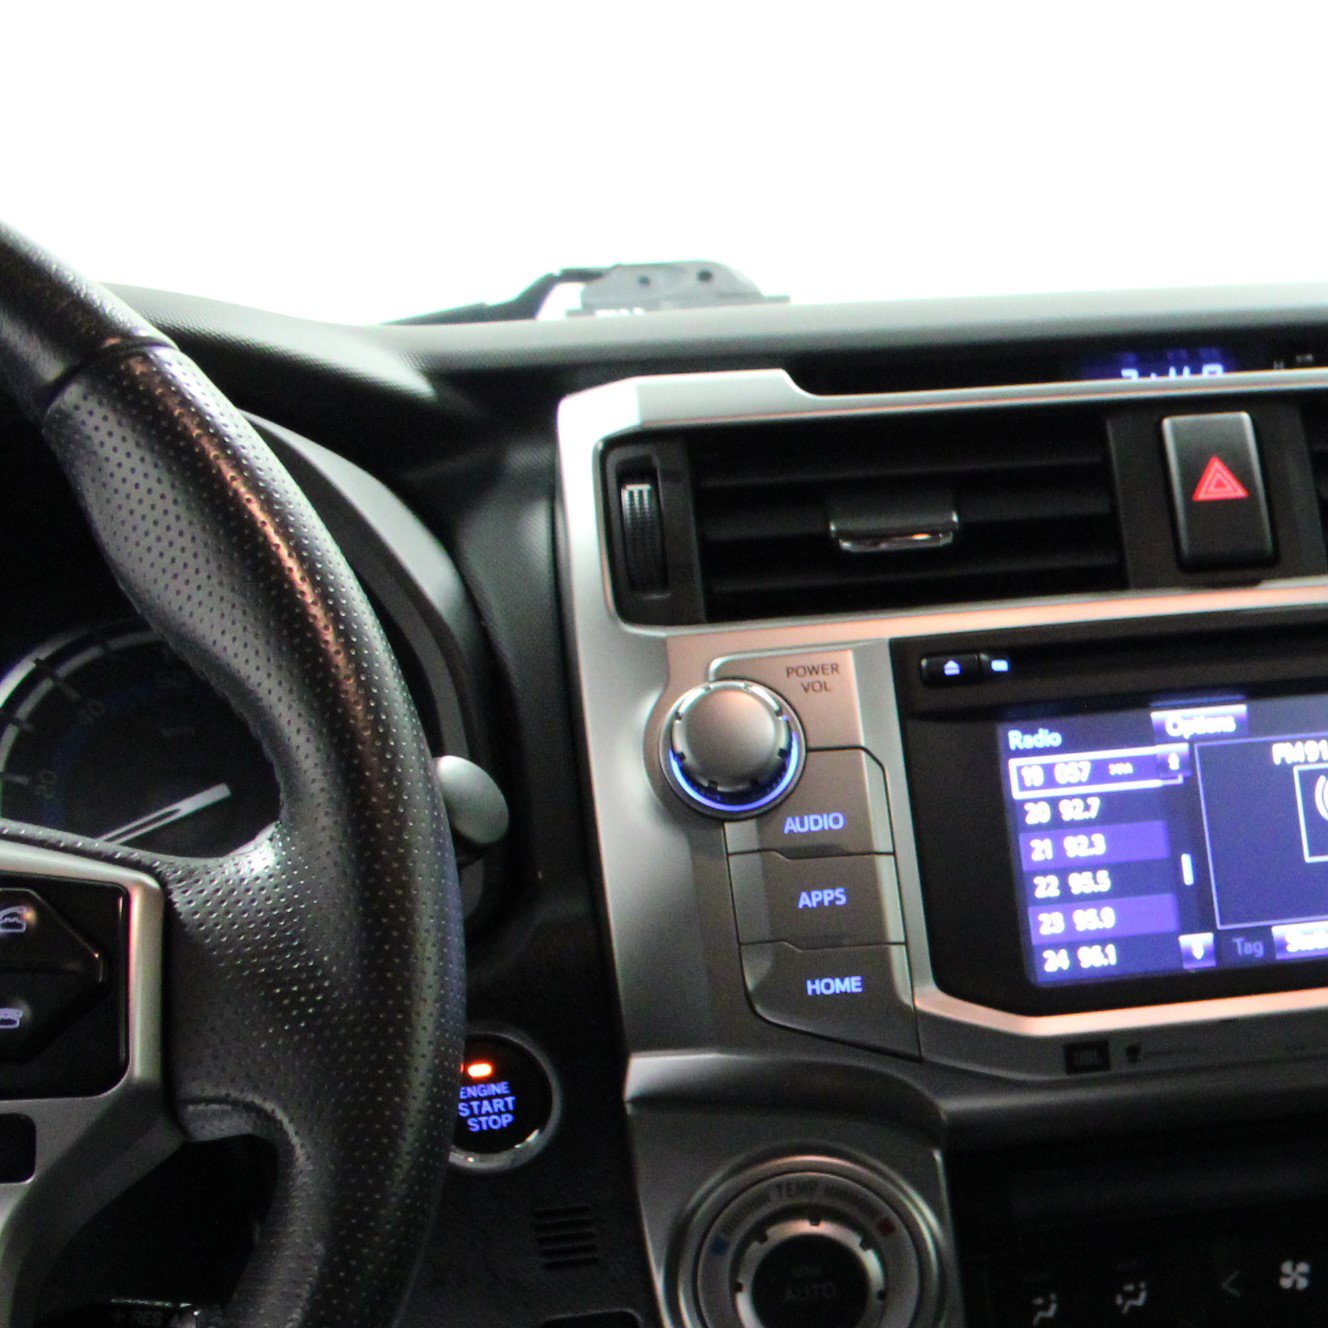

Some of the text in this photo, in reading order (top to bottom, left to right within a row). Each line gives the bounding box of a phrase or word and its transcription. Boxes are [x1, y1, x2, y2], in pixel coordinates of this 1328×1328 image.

[784, 662, 841, 680] POWER
[800, 679, 833, 694] VOL
[1008, 728, 1062, 750] Radio
[783, 811, 845, 835] AUDIO
[1024, 802, 1051, 825] 20
[1030, 838, 1053, 862] 21
[1033, 874, 1061, 898] 22
[797, 887, 847, 910] APPS
[1232, 936, 1265, 958] Tag
[1043, 948, 1070, 973] 24
[805, 976, 865, 997] HOME
[459, 1081, 510, 1100] ENGINE
[457, 1096, 516, 1118] START
[466, 1113, 514, 1133] STOP
